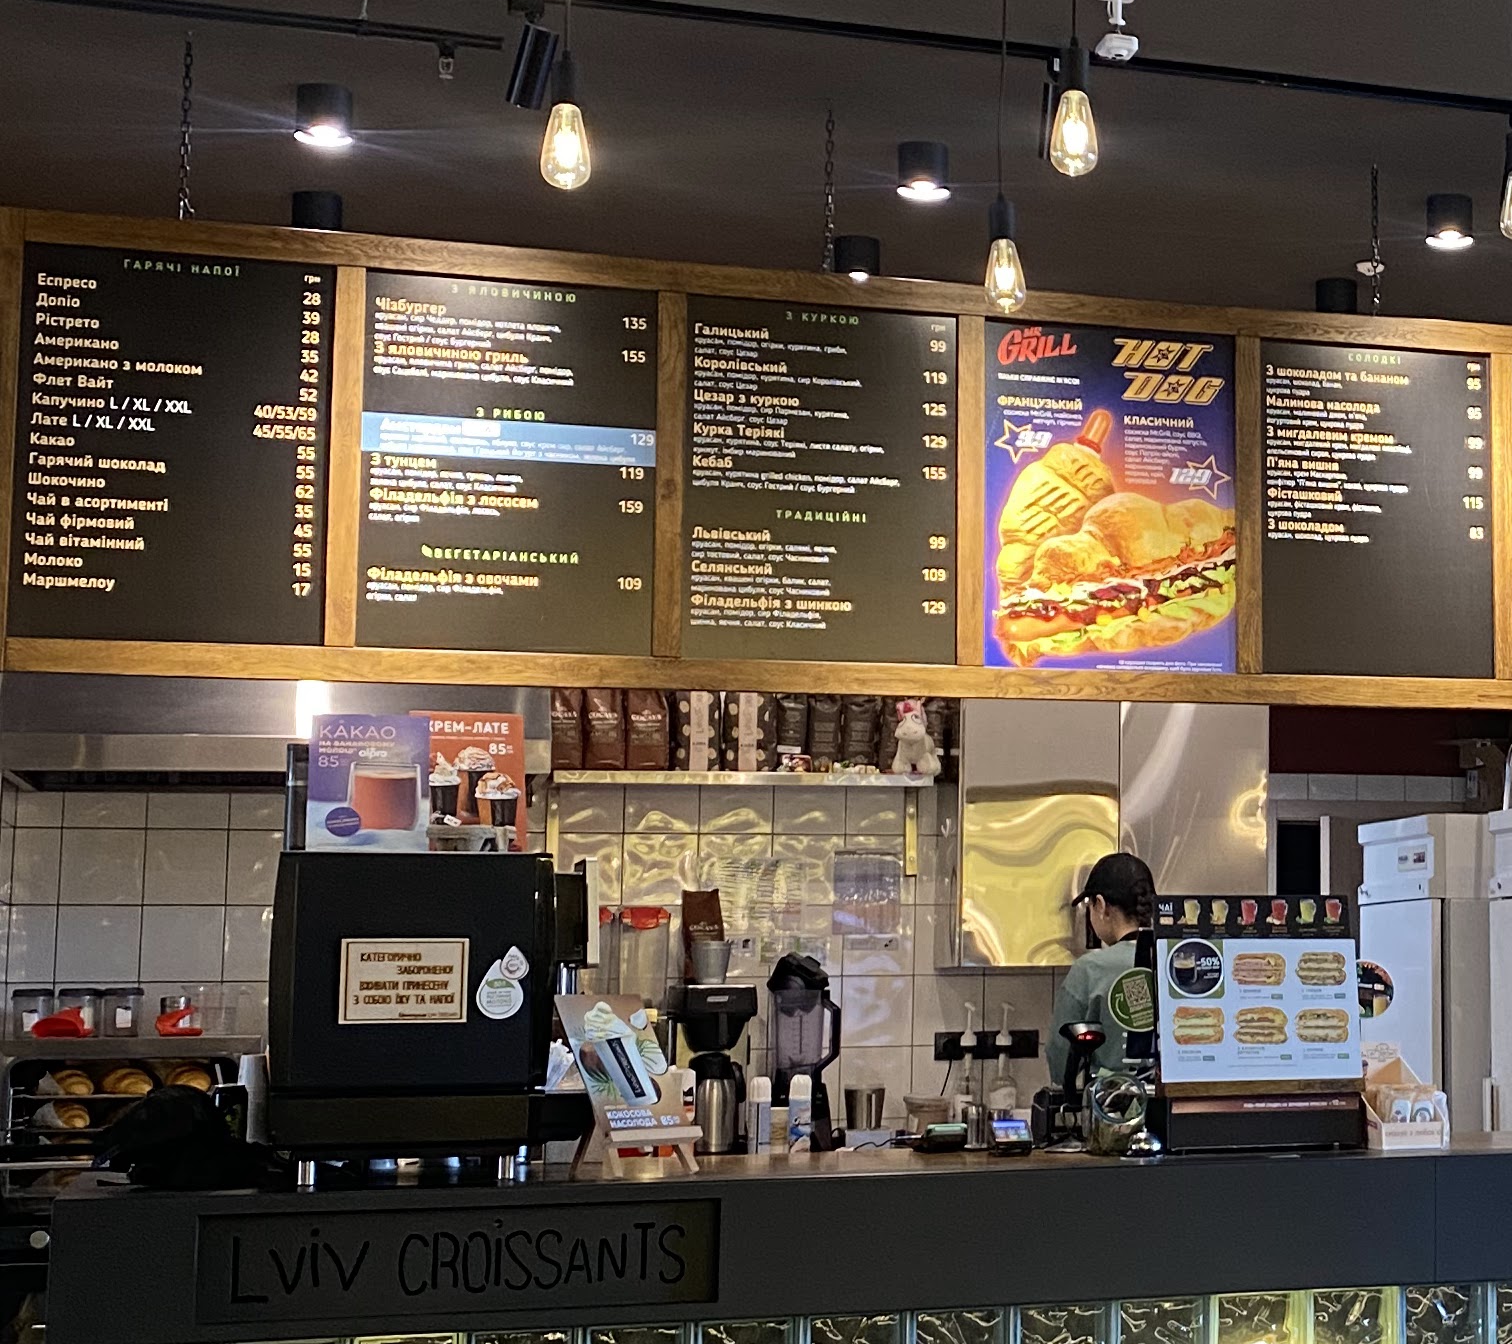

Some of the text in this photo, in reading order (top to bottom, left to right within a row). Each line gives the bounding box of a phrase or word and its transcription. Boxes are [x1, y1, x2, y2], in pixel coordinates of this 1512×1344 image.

[124, 259, 240, 277] ГАРЯЧІ НАПОЇ
[304, 274, 321, 283] грн
[38, 273, 321, 306] Еспресо 28
[36, 293, 320, 325] Допіо 39
[375, 296, 647, 330] Чізбургер 135
[786, 311, 859, 325] З КУРКОЮ
[36, 313, 320, 344] Рістрето 28
[694, 323, 946, 352] Галицький 99
[34, 333, 319, 363] Американо 35
[374, 341, 646, 364] З яловичиною гриль 155
[997, 330, 1078, 365] GRILL
[1111, 338, 1214, 372] HOT
[33, 353, 318, 383] Американо з молоком 42
[694, 356, 947, 385] Королівський 119
[1266, 365, 1481, 391] З шоколадом та бананом 95
[33, 373, 318, 402] Флет Вайт 52
[1121, 371, 1225, 406] DOG
[32, 393, 105, 409] Капучино
[110, 397, 118, 409] L
[132, 398, 150, 411] XL
[165, 400, 192, 414] XXL
[253, 405, 317, 421] 40/53/59
[476, 407, 545, 420] З РИБОЮ
[694, 389, 734, 403] Цезар
[750, 396, 800, 407] куркою
[922, 403, 947, 416] 125
[997, 395, 1083, 411] ФРАНЦУЗЬКИЙ
[1266, 395, 1482, 420] Малинова насолода 95
[1124, 415, 1194, 428] КЛАСИЧНИЙ
[30, 432, 315, 461] Какао 55
[694, 422, 947, 448] Курка Теріякі 129
[29, 452, 315, 479] Гарячий шоколад 55
[370, 453, 644, 480] З тунцем 119
[692, 455, 947, 480] Кебаб 155
[1169, 468, 1213, 485] 129
[28, 473, 314, 499] Шокочино 62
[1267, 487, 1484, 509] Фісташковий 115
[27, 492, 313, 518] Чай в асортименті 35
[776, 510, 867, 523] ТРАДИЦІЙНІ
[26, 512, 313, 537] Чай фірмовий 45
[25, 532, 312, 557] Чай вітамінний 55
[692, 526, 946, 549] Львівський 99
[24, 553, 311, 577] Молоко 15
[434, 547, 579, 564] ВЕГЕТАРІАНСЬКИЙ
[367, 566, 642, 590] Філадельфія з овочами 109
[692, 560, 946, 581] Селянський 109
[23, 573, 311, 596] Маршмелоу 17
[360, 952, 422, 962] КАТЕГОРИЧНО
[360, 980, 449, 990] ВЖИВАТИ ПРИНЕСЕНУ
[353, 993, 454, 1005] З СОБОЮ ЇЖУ ТА НАПОЇ
[606, 1110, 653, 1119] КОКОСОВА
[610, 1118, 657, 1128] НАСОЛОДА
